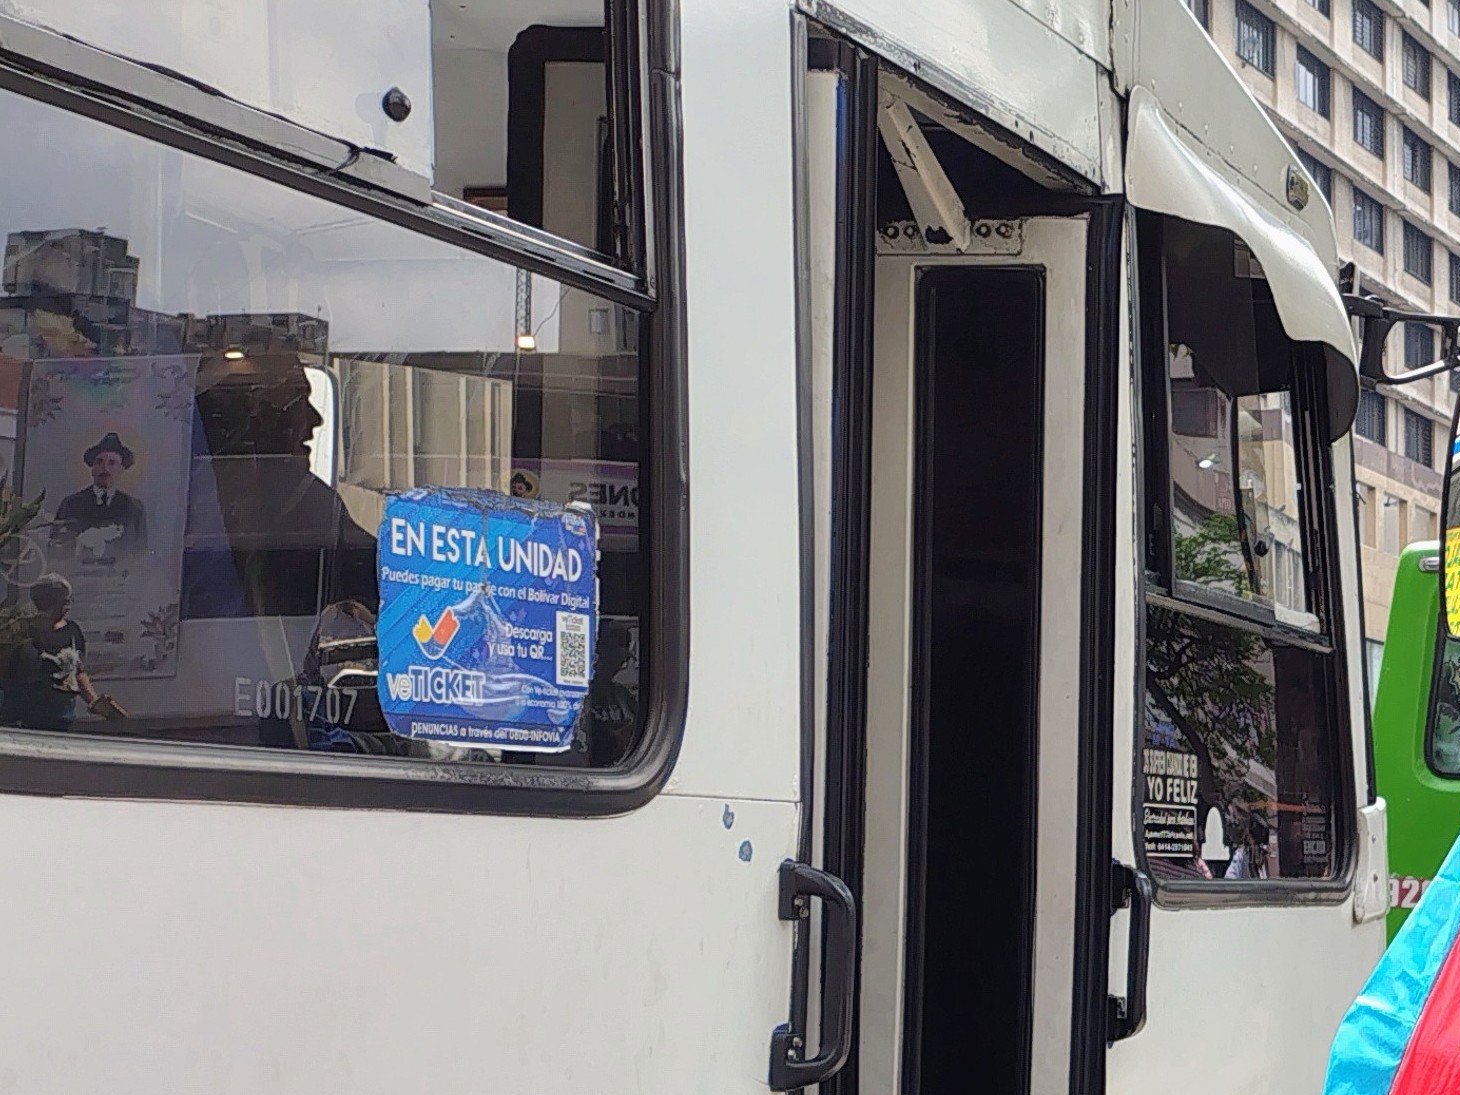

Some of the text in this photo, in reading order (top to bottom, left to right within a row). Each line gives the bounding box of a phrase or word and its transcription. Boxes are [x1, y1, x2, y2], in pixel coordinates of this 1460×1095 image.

[391, 517, 582, 582] EN ESTA UNIDAD
[381, 566, 419, 585] Puedes
[421, 576, 451, 591] pagar
[452, 578, 464, 590] tu
[497, 586, 516, 598] con
[517, 586, 527, 600] el
[561, 593, 590, 610] Digital
[497, 644, 515, 656] usa
[517, 643, 528, 658] tu
[505, 623, 553, 646] Descarga
[234, 676, 358, 725] E001707
[386, 666, 486, 706] veTICKET
[459, 726, 467, 736] a
[1147, 776, 1198, 804] YO FELIZ
